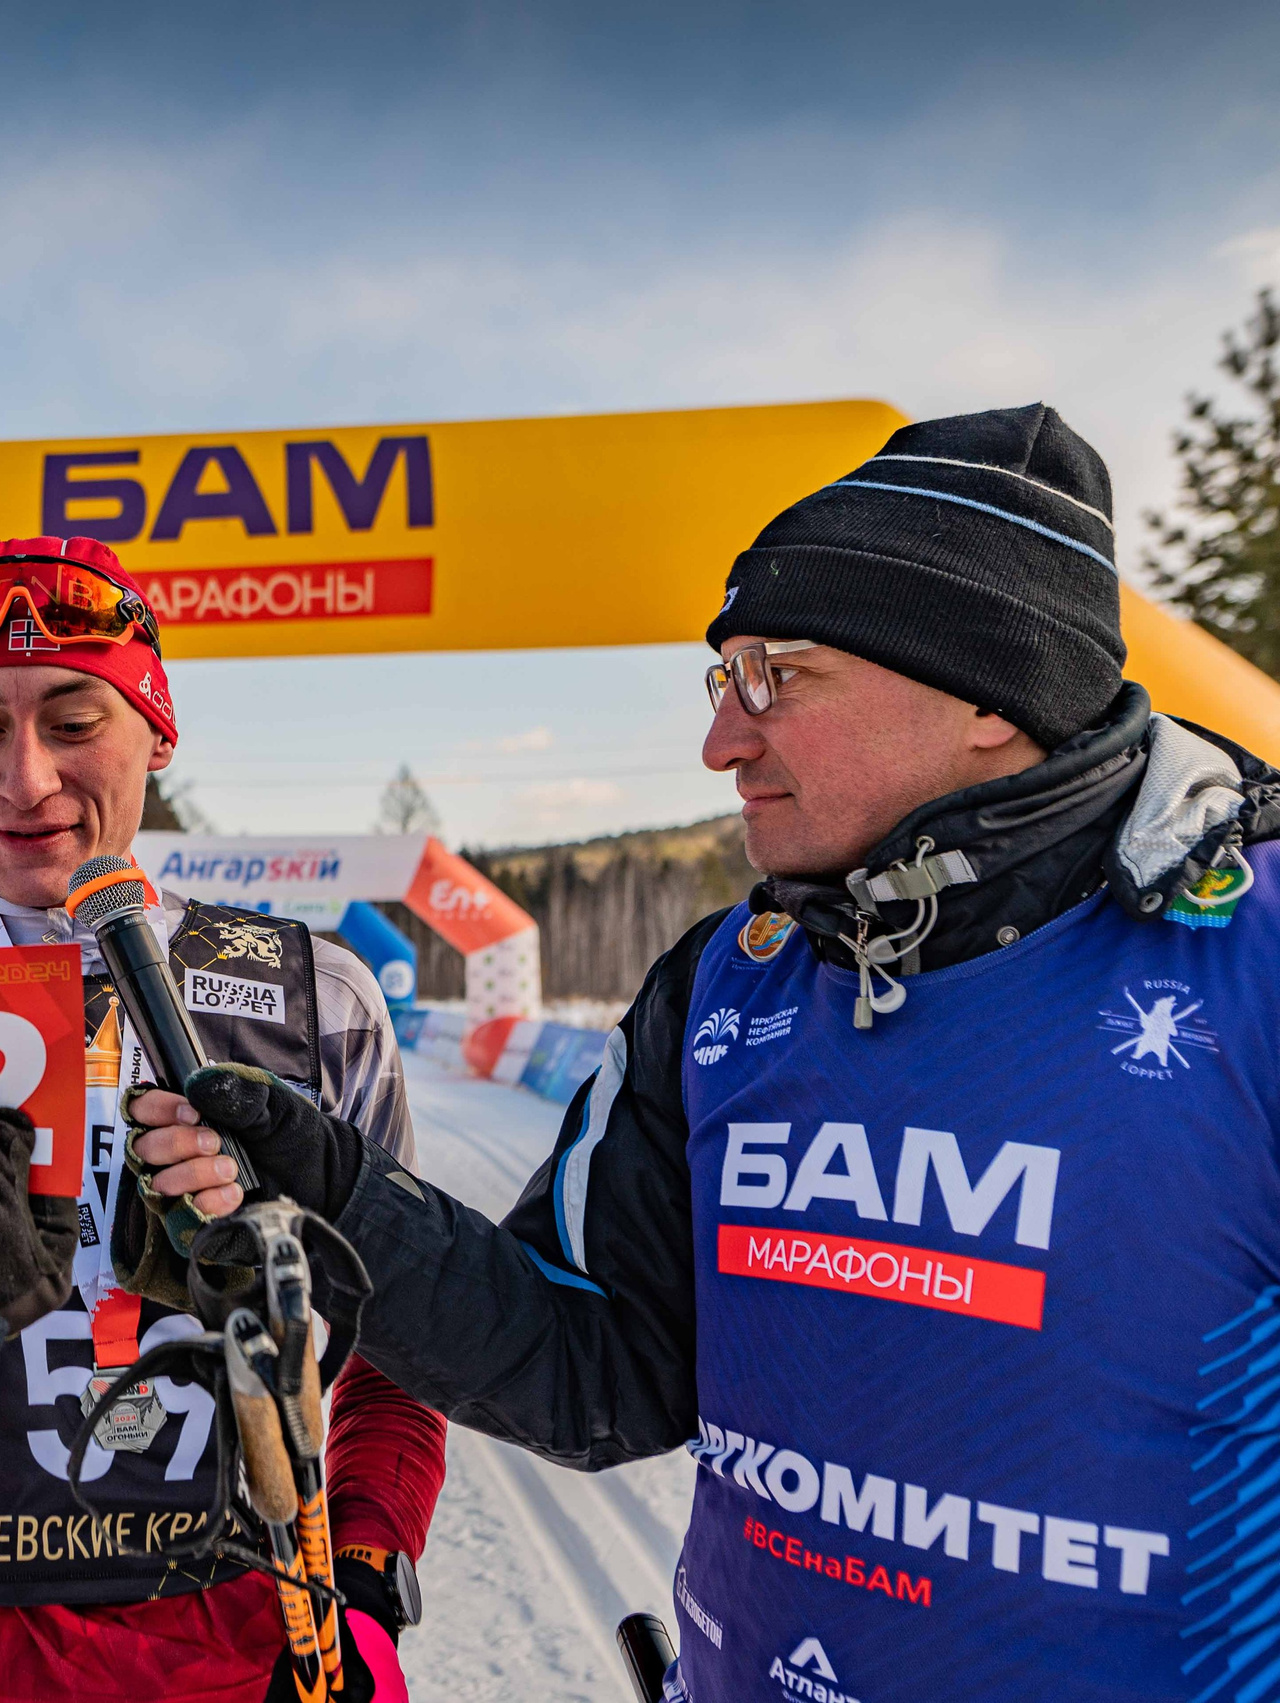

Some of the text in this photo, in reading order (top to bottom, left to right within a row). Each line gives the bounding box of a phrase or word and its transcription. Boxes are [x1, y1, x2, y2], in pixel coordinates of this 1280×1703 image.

[41, 435, 435, 544] БАМ
[150, 568, 375, 618] АРАФОНЫ
[192, 975, 277, 1002] RUSSIA
[1144, 979, 1191, 995] RUSSIA
[192, 991, 277, 1015] LOPPET
[747, 1017, 793, 1036] НЕФТЯНАЯ
[750, 1006, 799, 1026] ИРКУТСКАЯ
[745, 1027, 792, 1047] КОМПАНИЯ
[130, 1046, 142, 1085] НЬКИ
[1120, 1060, 1174, 1080] LOPPET
[719, 1120, 1062, 1251] БАМ
[747, 1235, 975, 1304] МАРАФОНЫ
[114, 1415, 137, 1423] 2024
[116, 1425, 137, 1433] БАМ
[107, 1431, 148, 1442] ОГОНЬКИ
[743, 1515, 933, 1608] #ВСЕнаБАМ
